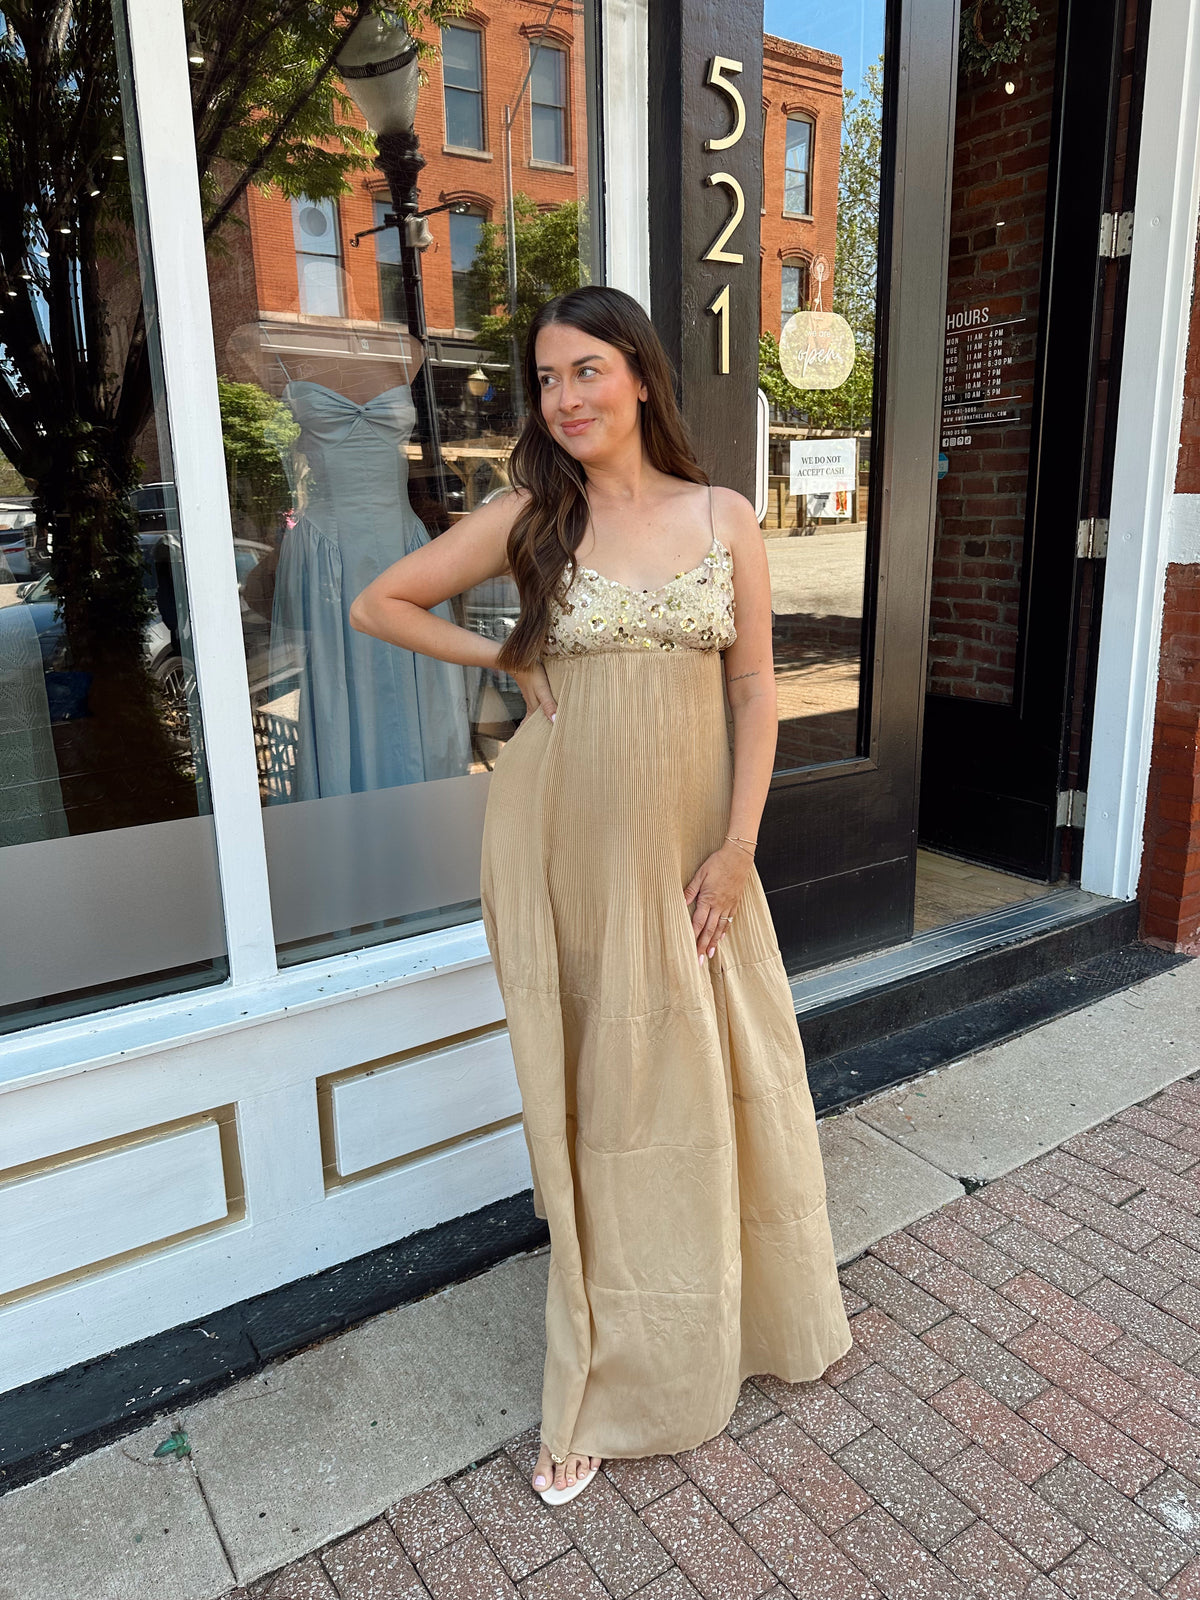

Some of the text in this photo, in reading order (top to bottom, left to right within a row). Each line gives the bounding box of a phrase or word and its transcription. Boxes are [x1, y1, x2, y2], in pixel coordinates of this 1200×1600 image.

[702, 55, 746, 375] 521
[946, 307, 989, 330] HOURS
[946, 347, 957, 355] TUE
[798, 344, 843, 377] open
[946, 366, 957, 374] THU
[987, 359, 1001, 367] 6:30
[1003, 357, 1012, 365] PM
[815, 456, 825, 464] DO
[798, 468, 825, 477] ACCEPT
